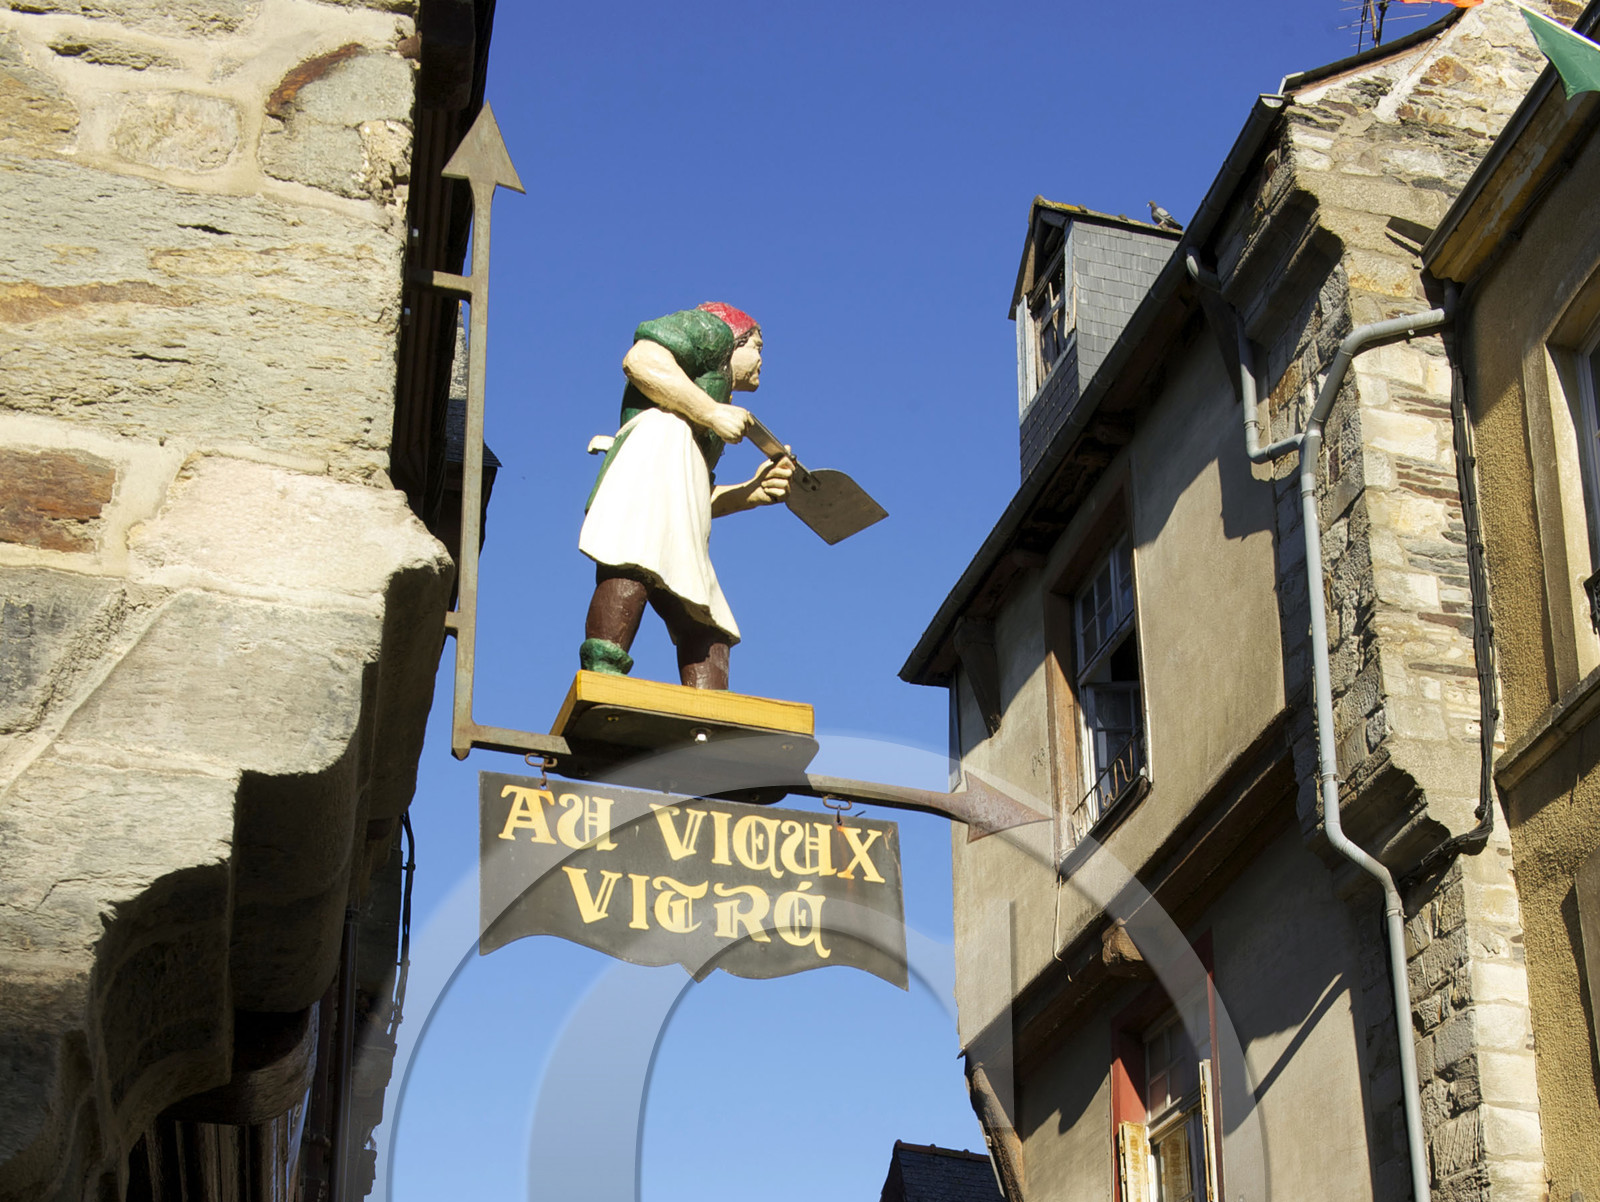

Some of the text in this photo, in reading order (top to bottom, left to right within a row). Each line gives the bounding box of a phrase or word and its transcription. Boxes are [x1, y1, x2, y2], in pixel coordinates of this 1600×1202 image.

[498, 784, 886, 884] AU VIEUX
[562, 865, 832, 959] VITRÉ
